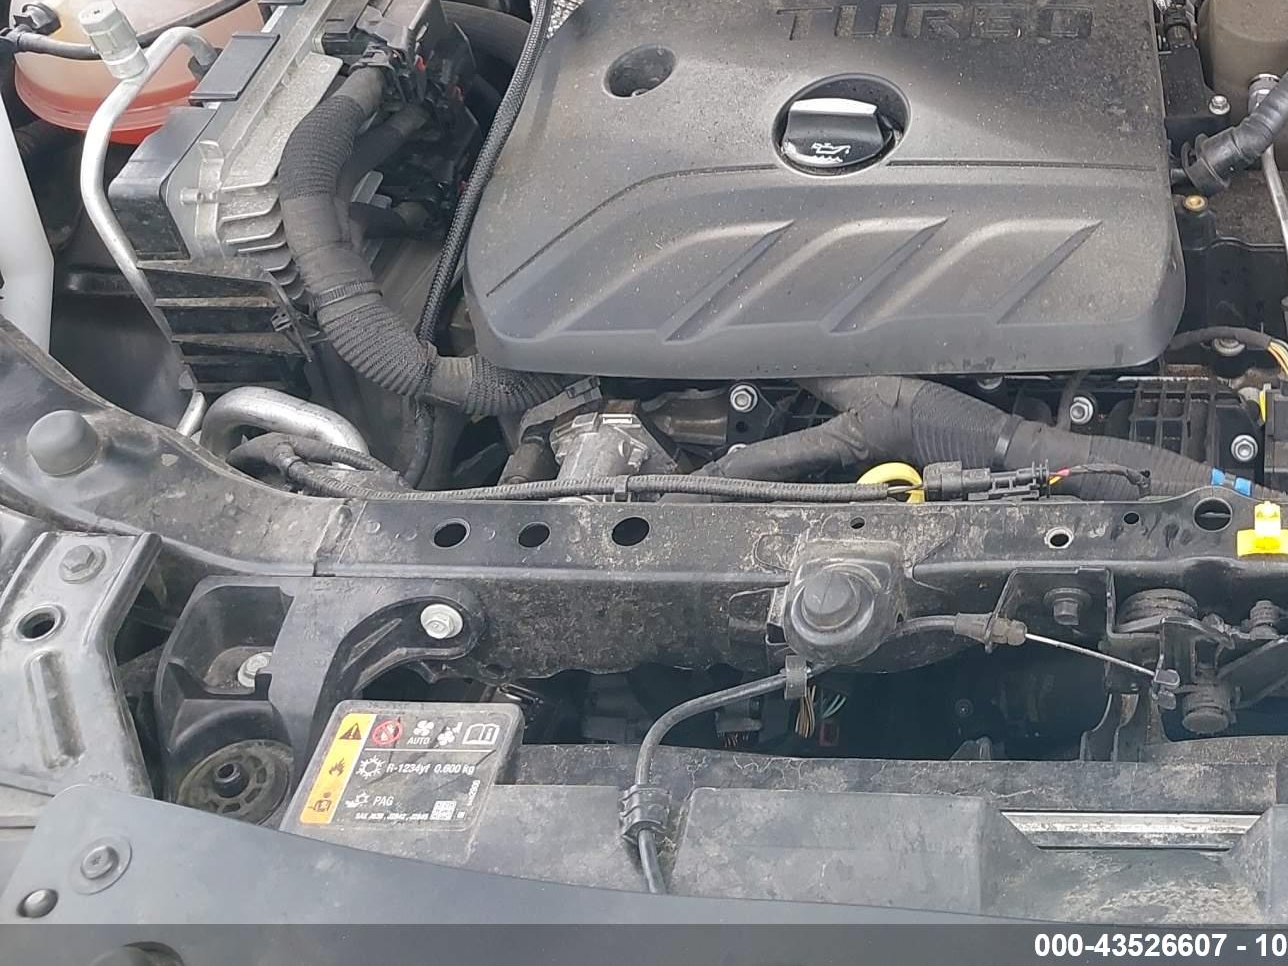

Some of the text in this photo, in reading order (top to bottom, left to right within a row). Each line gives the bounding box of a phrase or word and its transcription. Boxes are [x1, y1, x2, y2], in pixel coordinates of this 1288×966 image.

[776, 3, 1094, 40] TURBO
[407, 736, 430, 745] AUTO
[386, 763, 476, 775] R-1234yf 0.600 kg
[372, 796, 394, 807] PAG
